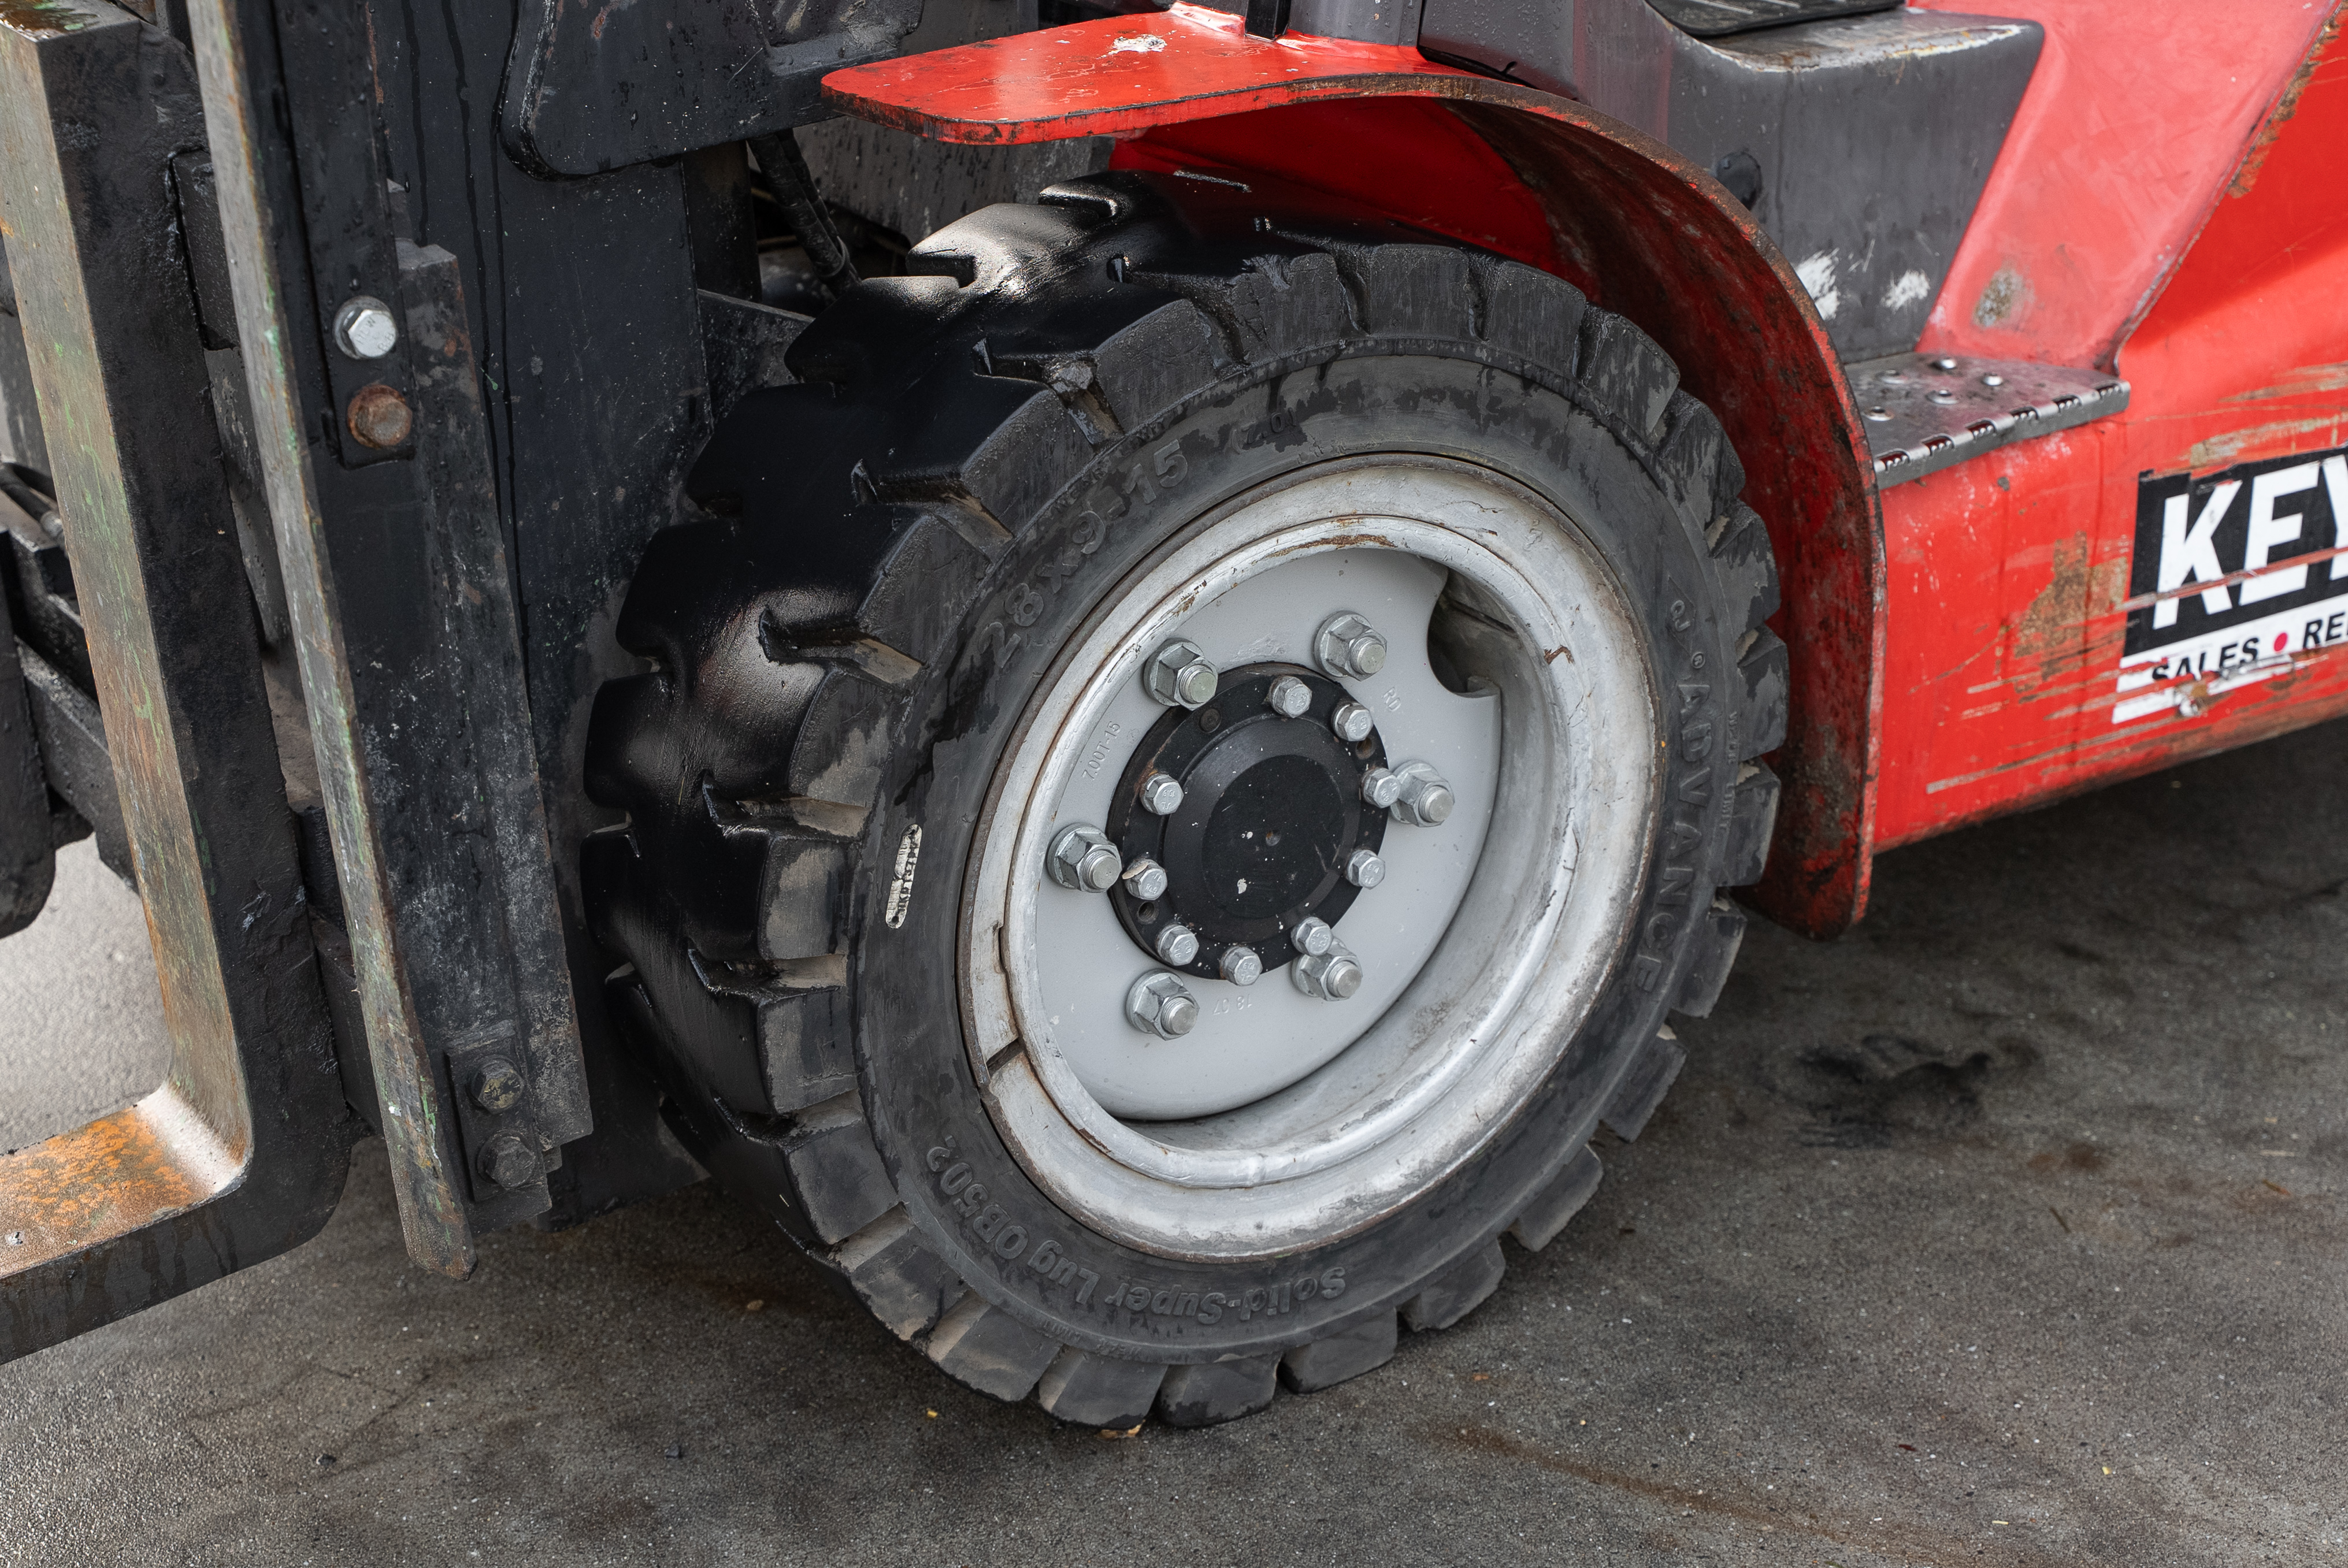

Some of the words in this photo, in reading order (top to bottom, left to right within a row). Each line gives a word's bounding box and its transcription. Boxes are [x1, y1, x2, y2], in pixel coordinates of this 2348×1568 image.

[1381, 686, 1401, 712] RD
[1081, 720, 1121, 781] 7.00T-15
[1636, 683, 1713, 992] ADVANCE
[925, 1134, 1030, 1261] OB502
[1028, 1238, 1101, 1305] Lug
[1103, 1263, 1347, 1324] Solid-Super
